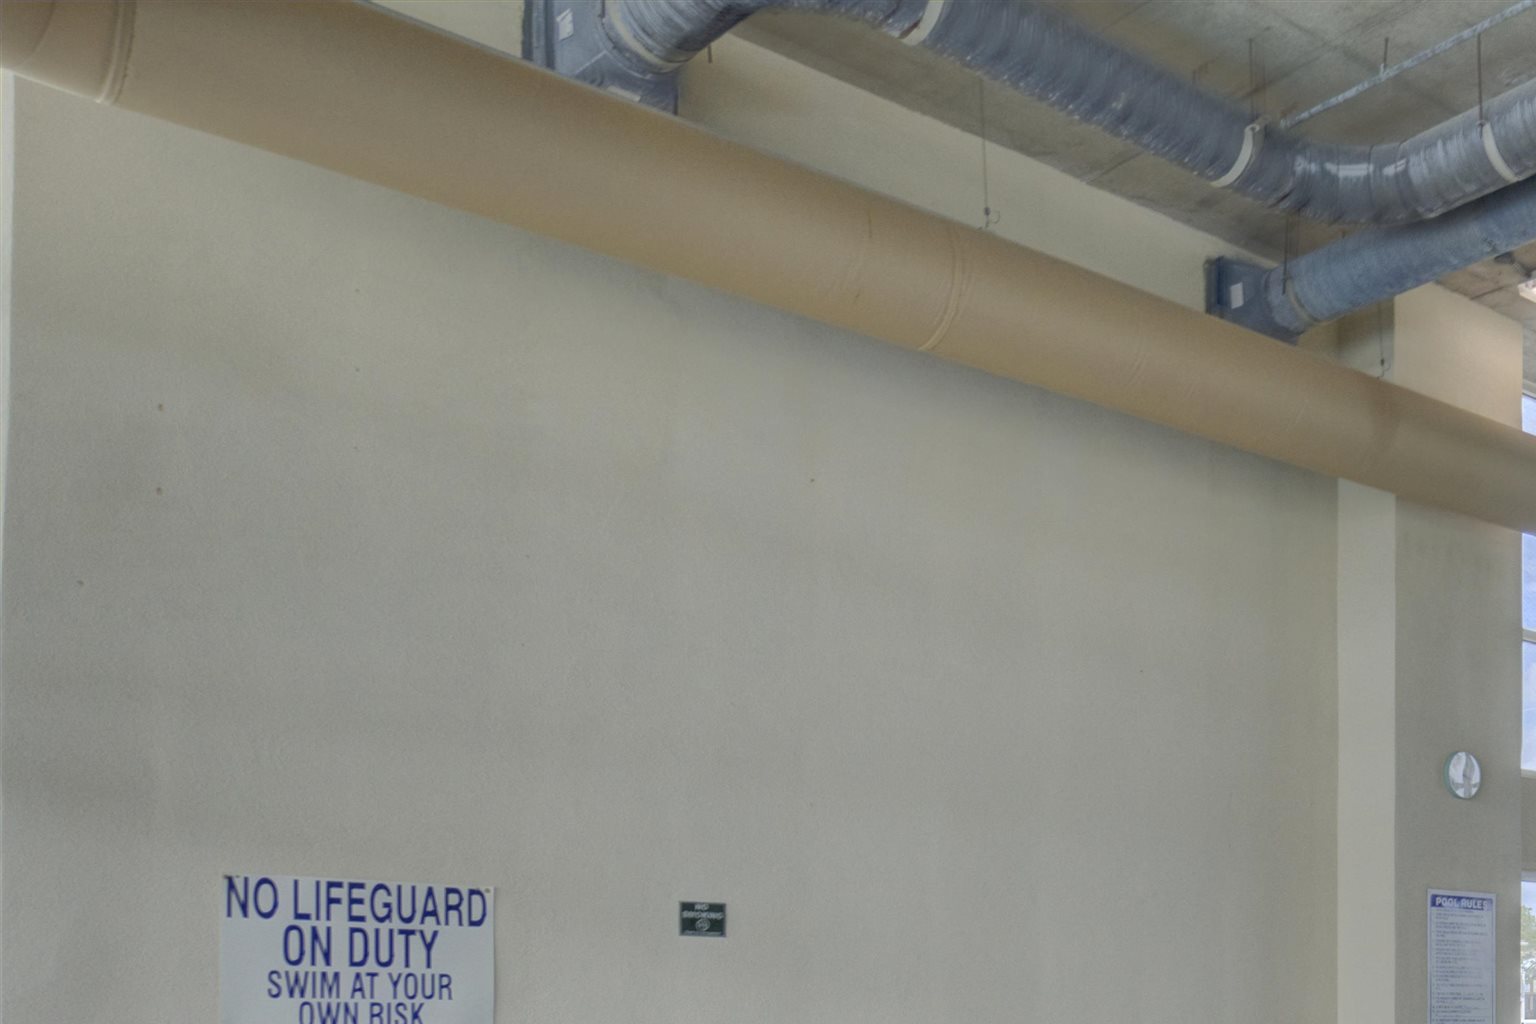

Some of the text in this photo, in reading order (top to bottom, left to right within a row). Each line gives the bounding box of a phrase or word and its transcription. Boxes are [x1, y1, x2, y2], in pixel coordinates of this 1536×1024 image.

[225, 876, 487, 927] NO LIFEGUARD
[1435, 897, 1487, 911] POOL RULES
[283, 924, 439, 969] ON DUTY
[267, 970, 453, 1001] SWIM AT YOUR
